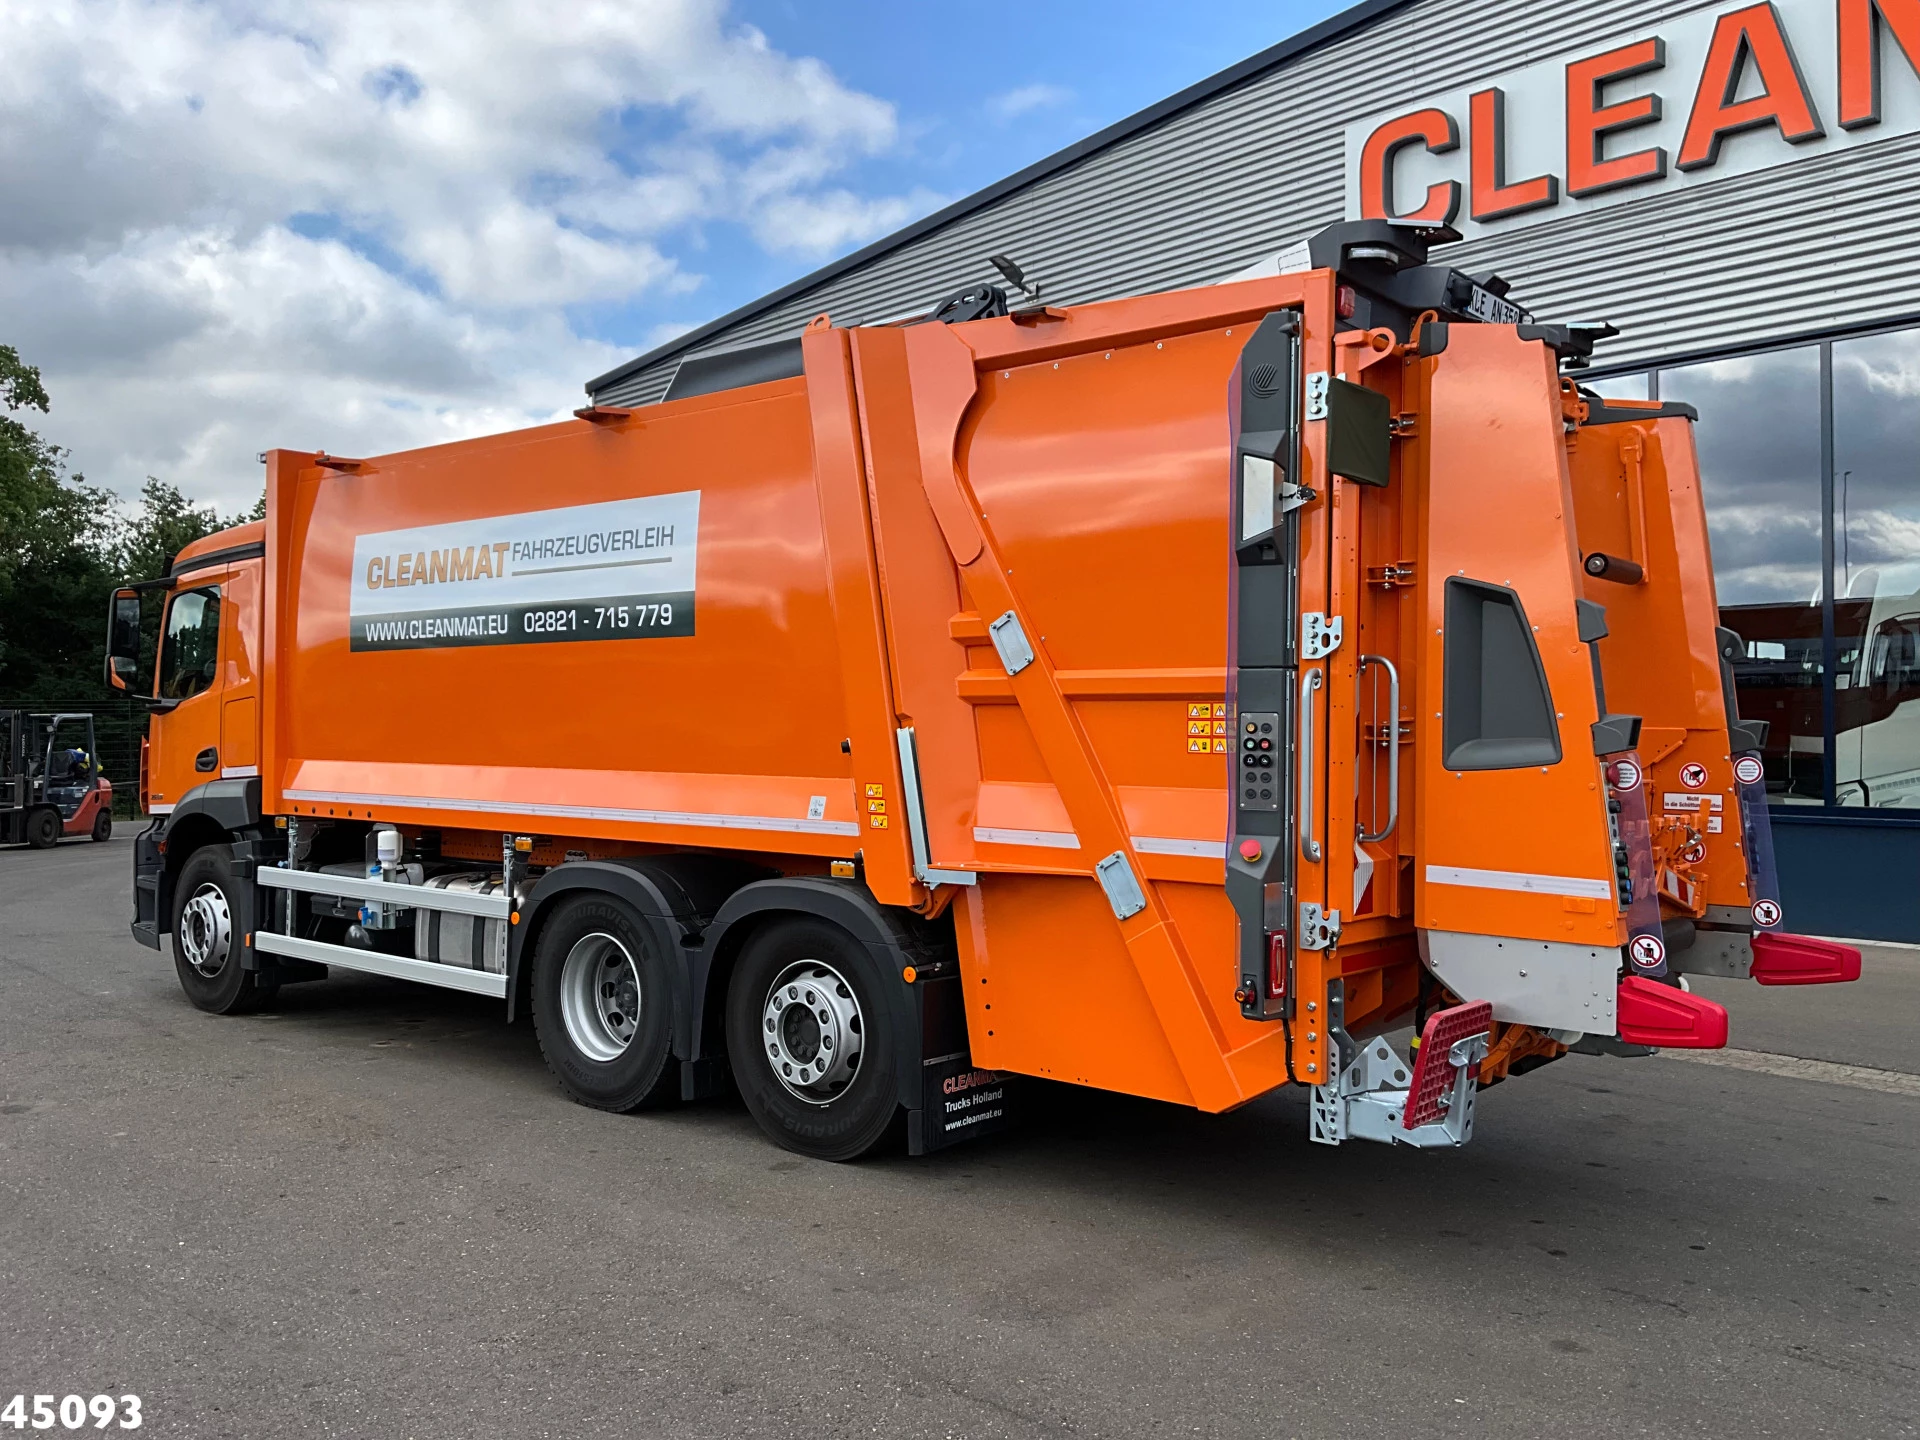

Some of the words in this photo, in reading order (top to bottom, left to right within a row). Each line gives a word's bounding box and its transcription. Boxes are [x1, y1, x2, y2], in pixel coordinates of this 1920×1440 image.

[366, 542, 510, 590] CLEANMAT
[512, 525, 675, 562] FAHRZEUGVERLEIH
[365, 614, 508, 642] WWW.CLEANMAT.EU
[524, 609, 576, 633] 02821
[594, 606, 629, 629] 715
[635, 603, 673, 627] 779
[944, 1098, 971, 1113] Trucks
[972, 1088, 1003, 1105] Holland
[944, 1109, 1002, 1132] www.cleanmat.eu
